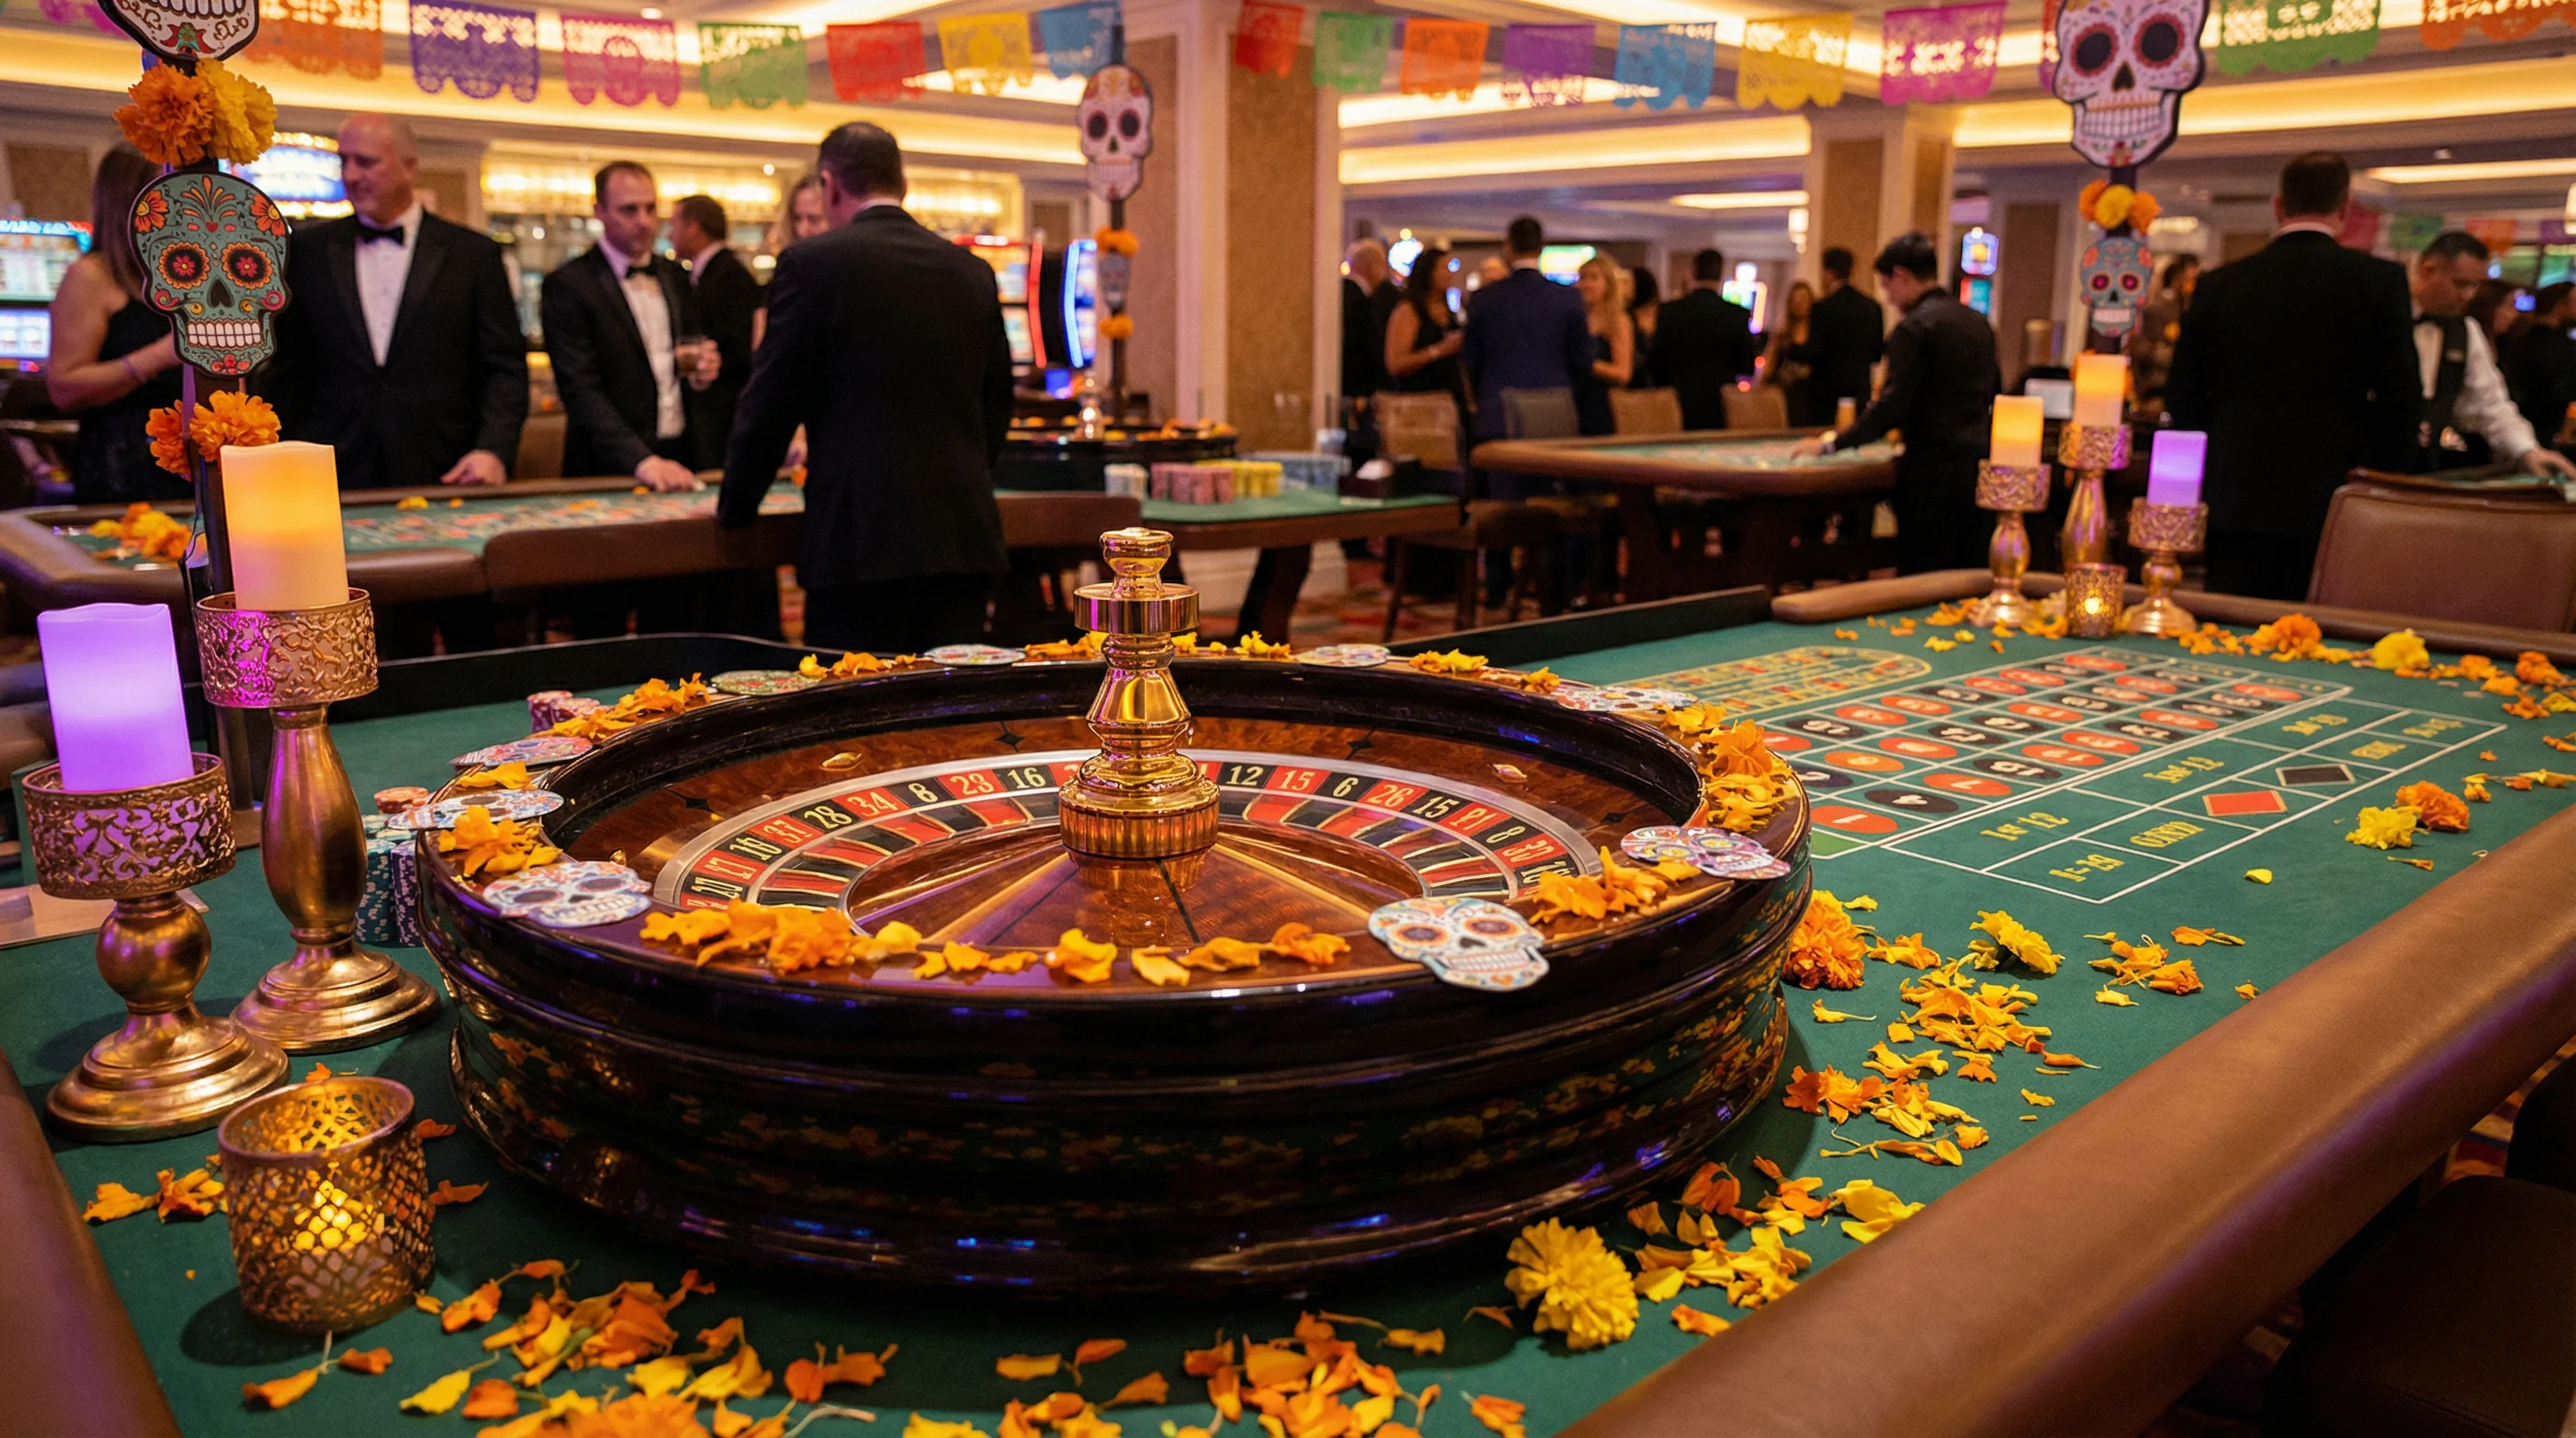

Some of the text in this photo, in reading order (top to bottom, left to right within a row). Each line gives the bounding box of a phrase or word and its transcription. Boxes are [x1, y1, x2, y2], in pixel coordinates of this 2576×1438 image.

[1006, 767, 1046, 789] 16
[1226, 765, 1264, 785] 12
[1277, 770, 1315, 791] 15
[908, 783, 938, 803] 8
[1333, 777, 1359, 797] 6
[1367, 784, 1414, 808] 26
[847, 791, 898, 817] 34
[1412, 796, 1460, 819] 15
[804, 805, 852, 829] 28
[1832, 814, 1868, 824] 1
[2017, 812, 2071, 829] 12
[1486, 826, 1526, 844] 8
